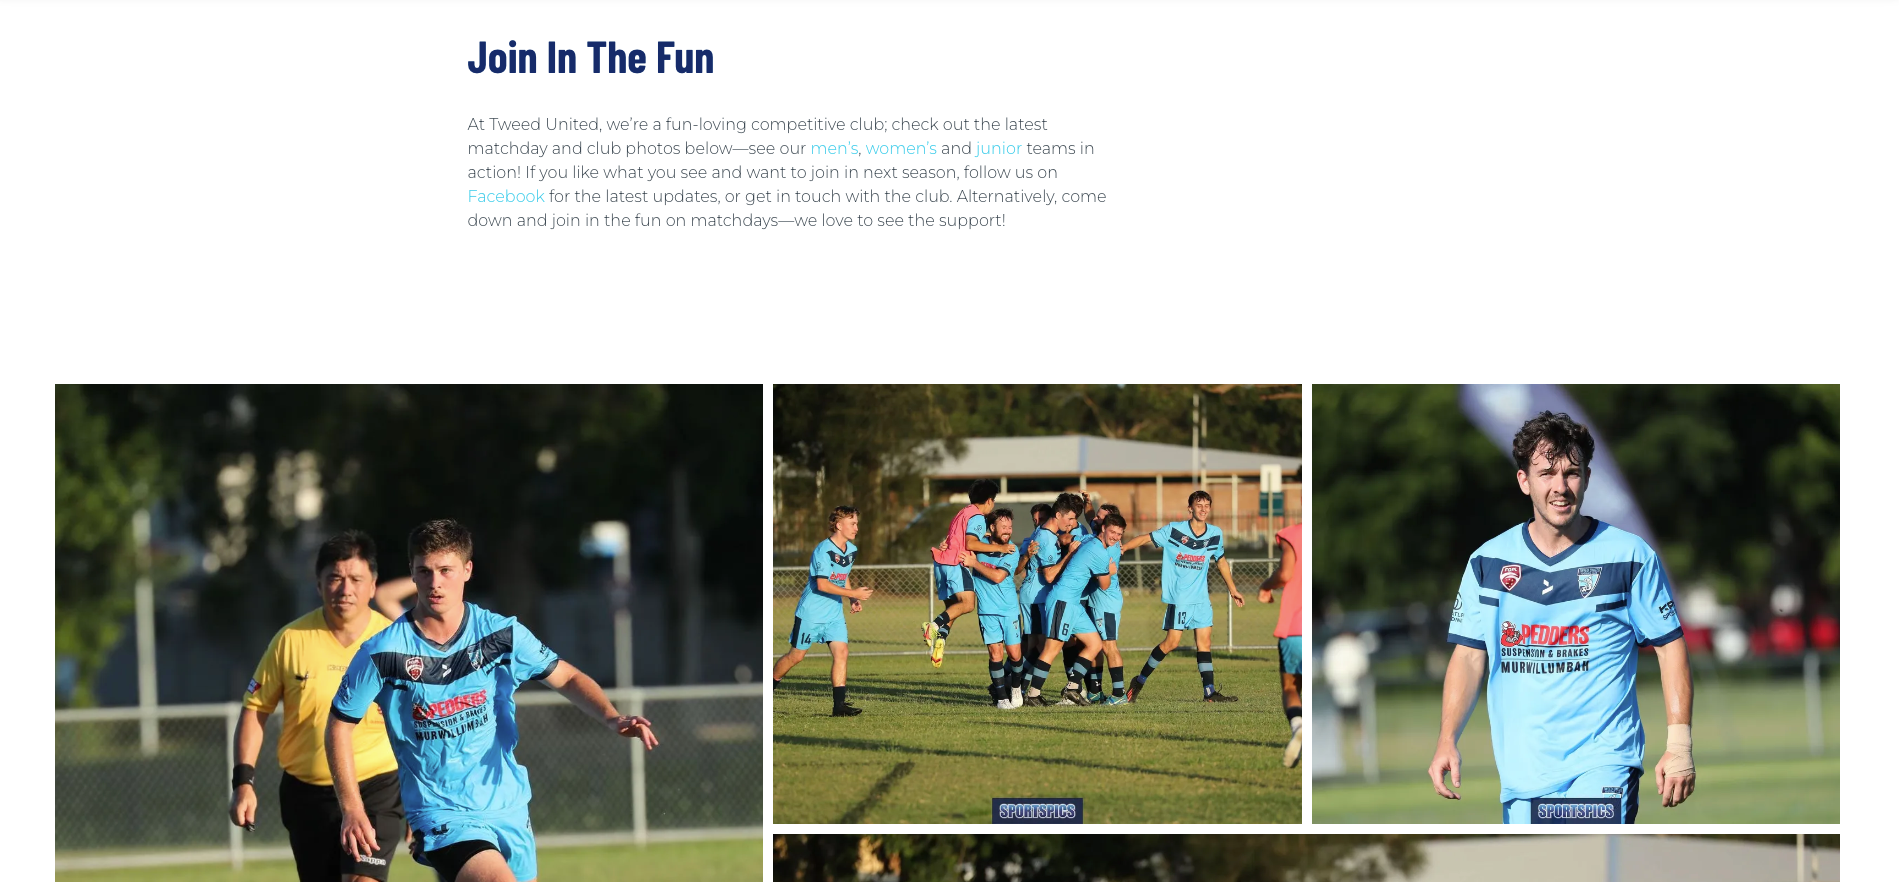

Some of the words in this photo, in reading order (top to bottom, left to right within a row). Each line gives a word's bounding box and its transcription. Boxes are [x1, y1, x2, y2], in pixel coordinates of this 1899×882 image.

[468, 40, 536, 74] Join
[548, 41, 576, 73] In
[587, 41, 646, 74] The
[658, 41, 713, 74] Fun
[467, 118, 485, 130] At
[489, 117, 540, 130] Tweed
[547, 117, 602, 133] United,
[653, 121, 661, 130] a
[666, 117, 746, 134] fun-loving
[751, 117, 845, 133] competitive
[850, 117, 887, 133] club;
[892, 117, 939, 130] check
[943, 119, 970, 130] out
[974, 117, 1000, 130] the
[1006, 117, 1048, 130] latest
[469, 141, 548, 158] matchday
[552, 141, 582, 154] and
[587, 141, 621, 154] club
[627, 141, 680, 157] photos
[686, 141, 775, 154] below—see
[780, 145, 806, 154] our
[942, 141, 971, 154] and
[974, 141, 1022, 157] junior
[1026, 143, 1075, 154] teams
[1081, 141, 1094, 154] in
[468, 165, 520, 178] action!
[527, 165, 536, 178] If
[539, 169, 567, 182] you
[574, 165, 599, 178] like
[603, 165, 643, 178] what
[647, 169, 675, 182] you
[681, 169, 707, 178] see
[712, 165, 741, 178] and
[746, 167, 786, 178] want
[790, 167, 806, 178] to
[809, 165, 839, 181] join
[845, 165, 858, 178] in
[864, 167, 898, 178] next
[902, 169, 959, 181] season,
[964, 165, 1011, 178] follow
[1016, 169, 1033, 178] us
[1038, 169, 1057, 178] on
[469, 189, 545, 202] Facebook
[549, 189, 570, 202] for
[574, 189, 601, 202] the
[607, 189, 648, 202] latest
[654, 189, 720, 205] updates,
[725, 193, 741, 202] or
[745, 191, 772, 206] get
[777, 189, 790, 202] in
[795, 189, 840, 202] touch
[845, 189, 879, 202] with
[884, 189, 911, 202] the
[916, 189, 952, 202] club.
[957, 189, 1057, 206] Alternatively,
[1062, 193, 1106, 202] come
[468, 213, 511, 226] down
[517, 213, 546, 226] and
[550, 213, 580, 229] join
[586, 213, 599, 226] in
[604, 213, 630, 226] the
[635, 213, 660, 226] fun
[666, 217, 685, 226] on
[692, 213, 817, 230] matchdays—we
[823, 213, 853, 226] love
[857, 215, 873, 226] to
[878, 217, 904, 226] see
[908, 213, 934, 226] the
[939, 214, 1005, 229] support!
[1178, 611, 1187, 625] 13
[1062, 623, 1070, 636] 6
[1521, 624, 1590, 646] PEDDERS
[801, 632, 811, 645] 14
[1548, 649, 1554, 658] &
[1556, 647, 1589, 658] BRAKES
[1501, 661, 1590, 674] MURWILLUMBAH
